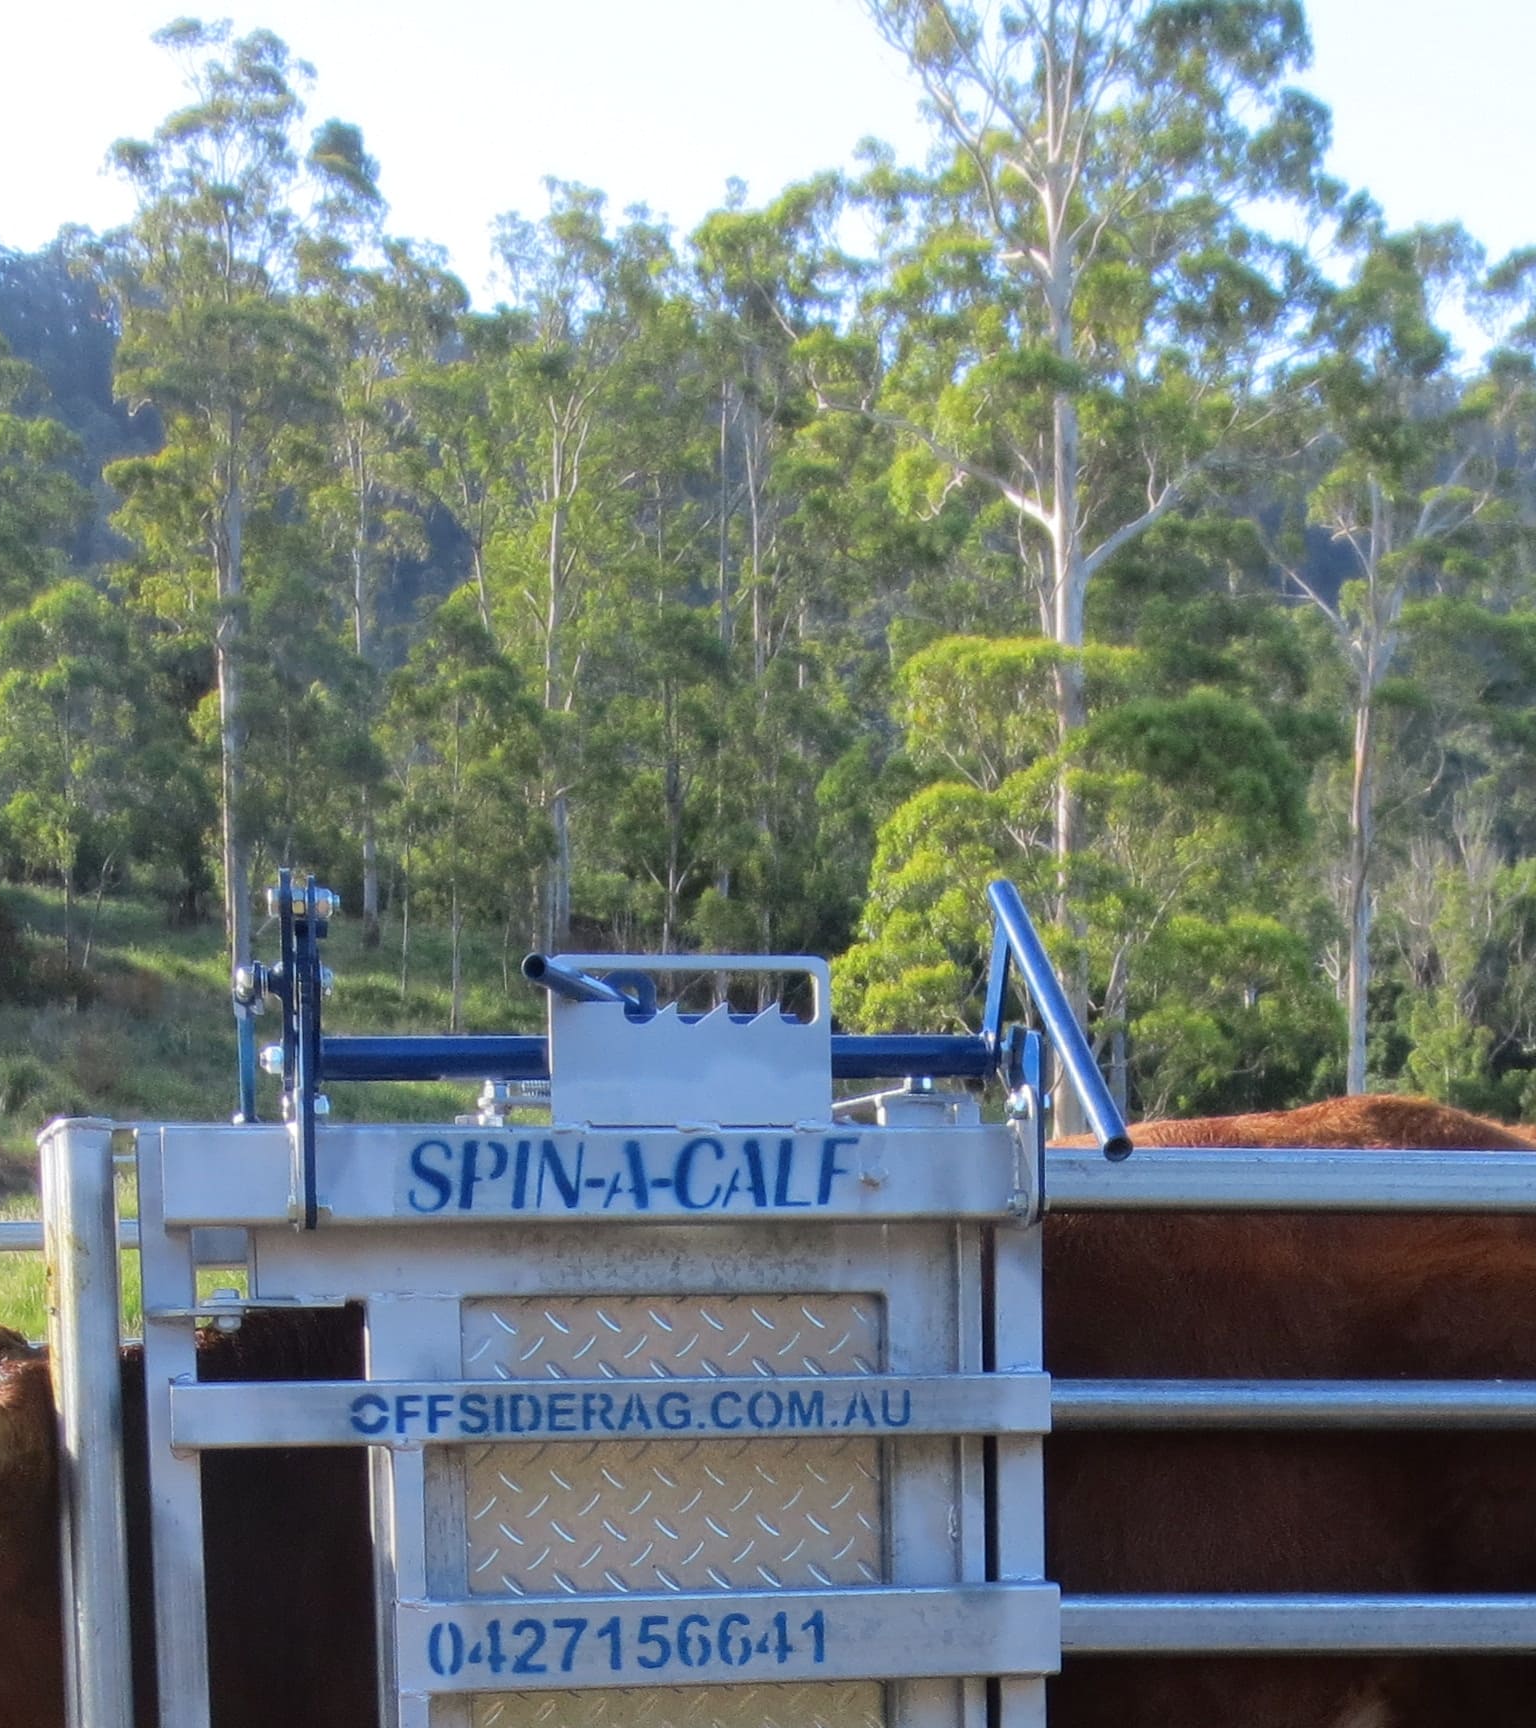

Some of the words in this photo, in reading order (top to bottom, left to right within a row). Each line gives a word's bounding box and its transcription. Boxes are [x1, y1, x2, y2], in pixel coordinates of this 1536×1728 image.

[408, 1136, 860, 1213] SPIN-A-CALF
[350, 1388, 912, 1435] OFFSIDERAG.COM.AU
[428, 1609, 825, 1677] 0427156641
